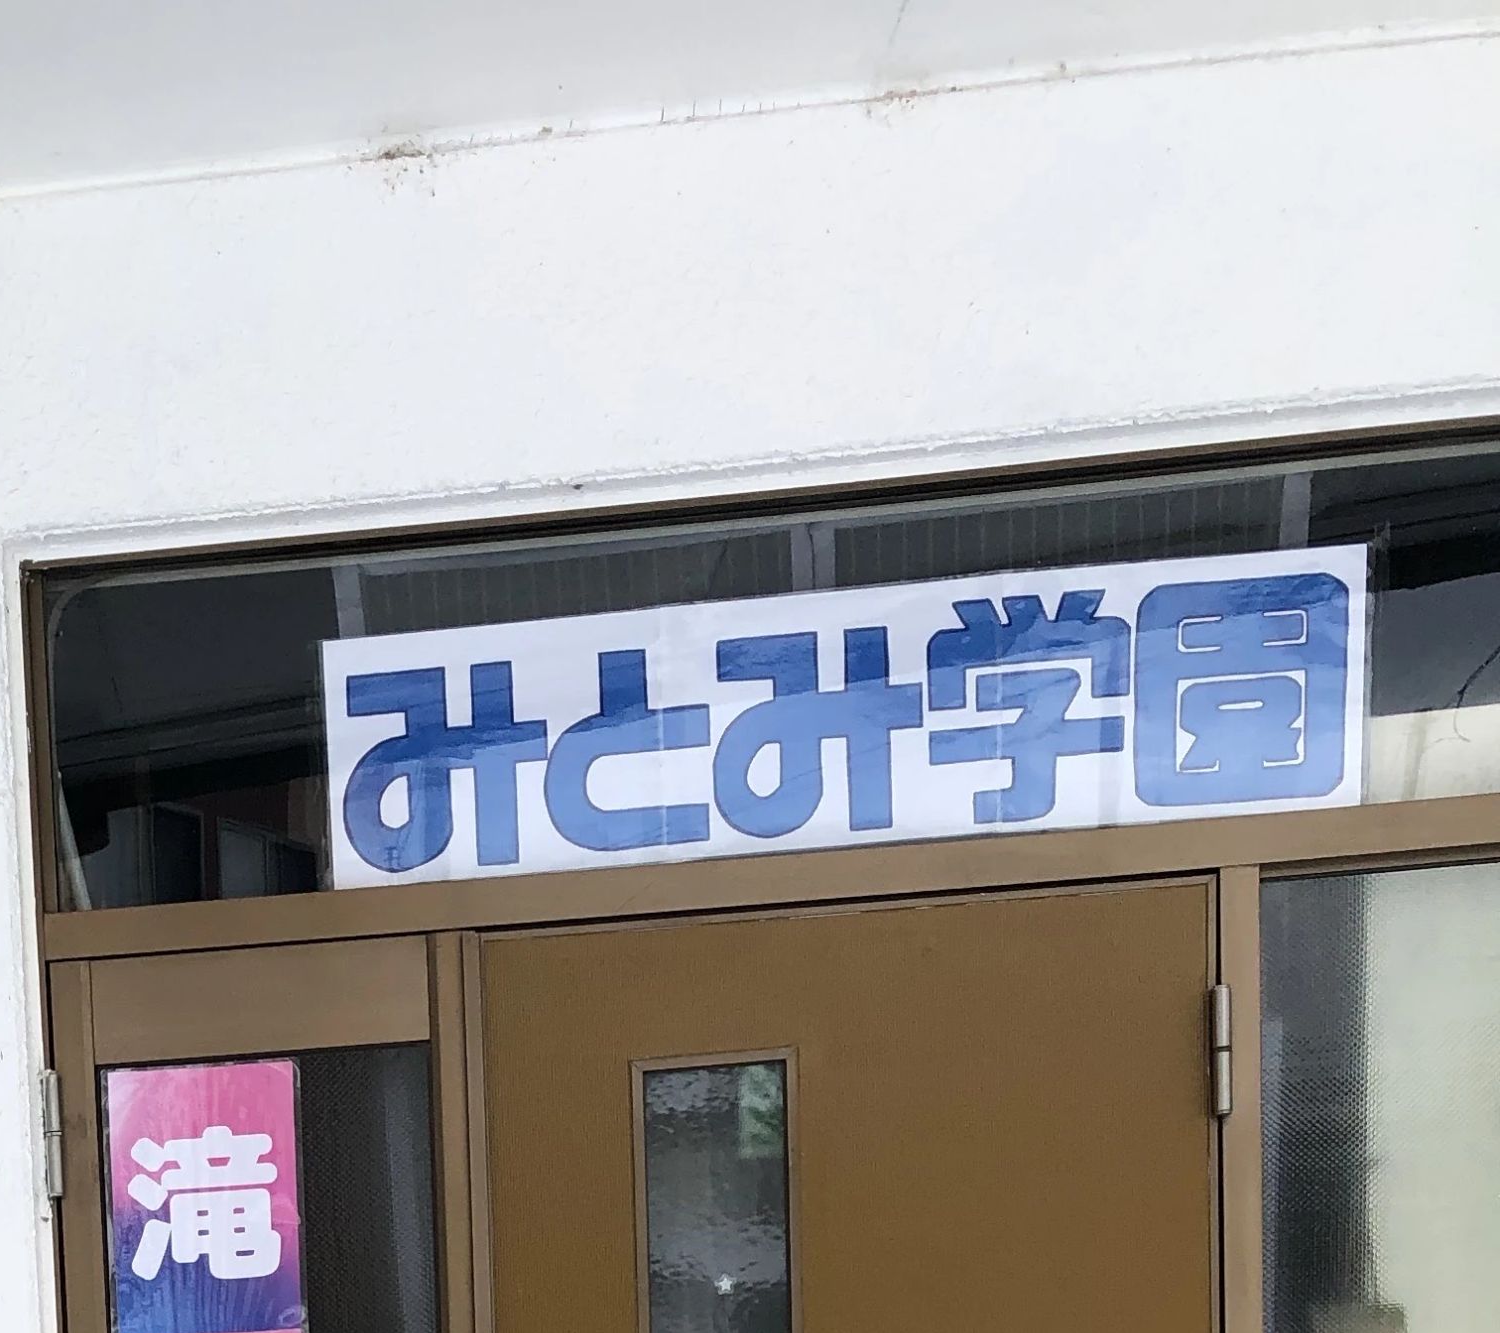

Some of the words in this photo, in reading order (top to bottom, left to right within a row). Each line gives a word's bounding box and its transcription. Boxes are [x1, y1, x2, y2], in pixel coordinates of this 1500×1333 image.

[343, 572, 1349, 873] みとみ学園
